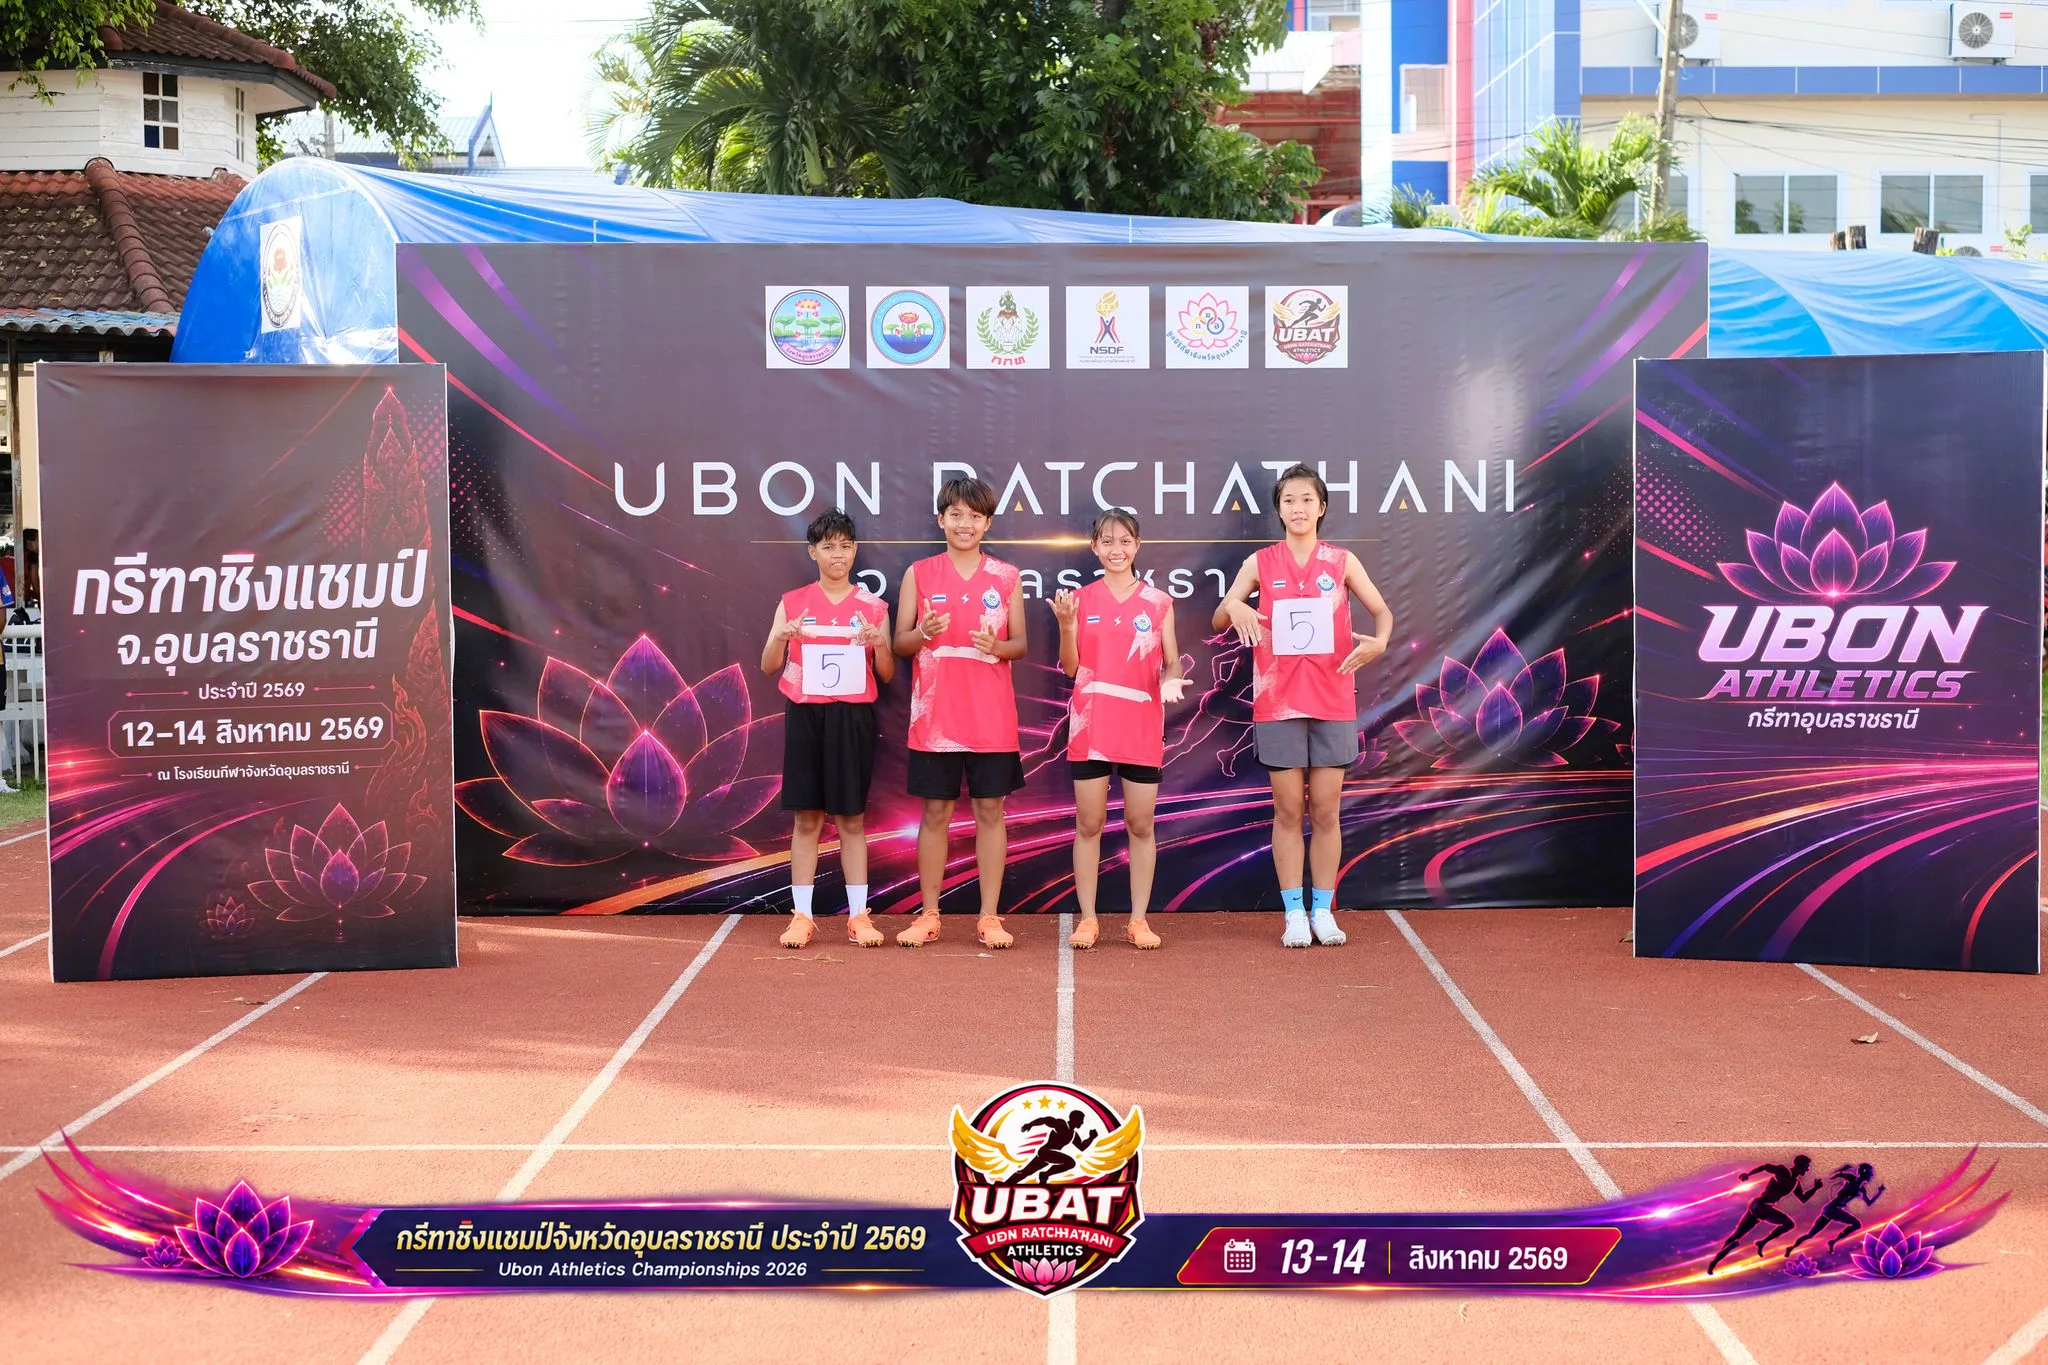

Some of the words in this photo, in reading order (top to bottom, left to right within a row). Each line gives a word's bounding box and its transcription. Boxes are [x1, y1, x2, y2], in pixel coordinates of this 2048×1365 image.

[1279, 328, 1335, 342] UBAT
[1090, 346, 1124, 355] NSDF
[614, 461, 881, 516] UBON
[73, 548, 428, 615] กรีฑาชิงแชมป์
[1289, 610, 1315, 650] 5
[1698, 605, 1989, 663] UBON
[117, 617, 379, 677] จ.อุบลราชธานี
[821, 653, 845, 689] 5
[1706, 669, 1976, 699] ATHLETICS
[198, 681, 257, 700] ประจำปี
[263, 682, 305, 698] 2569
[216, 718, 311, 744] สิงหาคม
[320, 716, 384, 741] 2569
[1747, 706, 1920, 734] กรีฑาอุบลราชธานี
[157, 770, 170, 781] ณ
[174, 761, 349, 781] โรงเรียนกีฬาจังหวัดอุบลราชธานี
